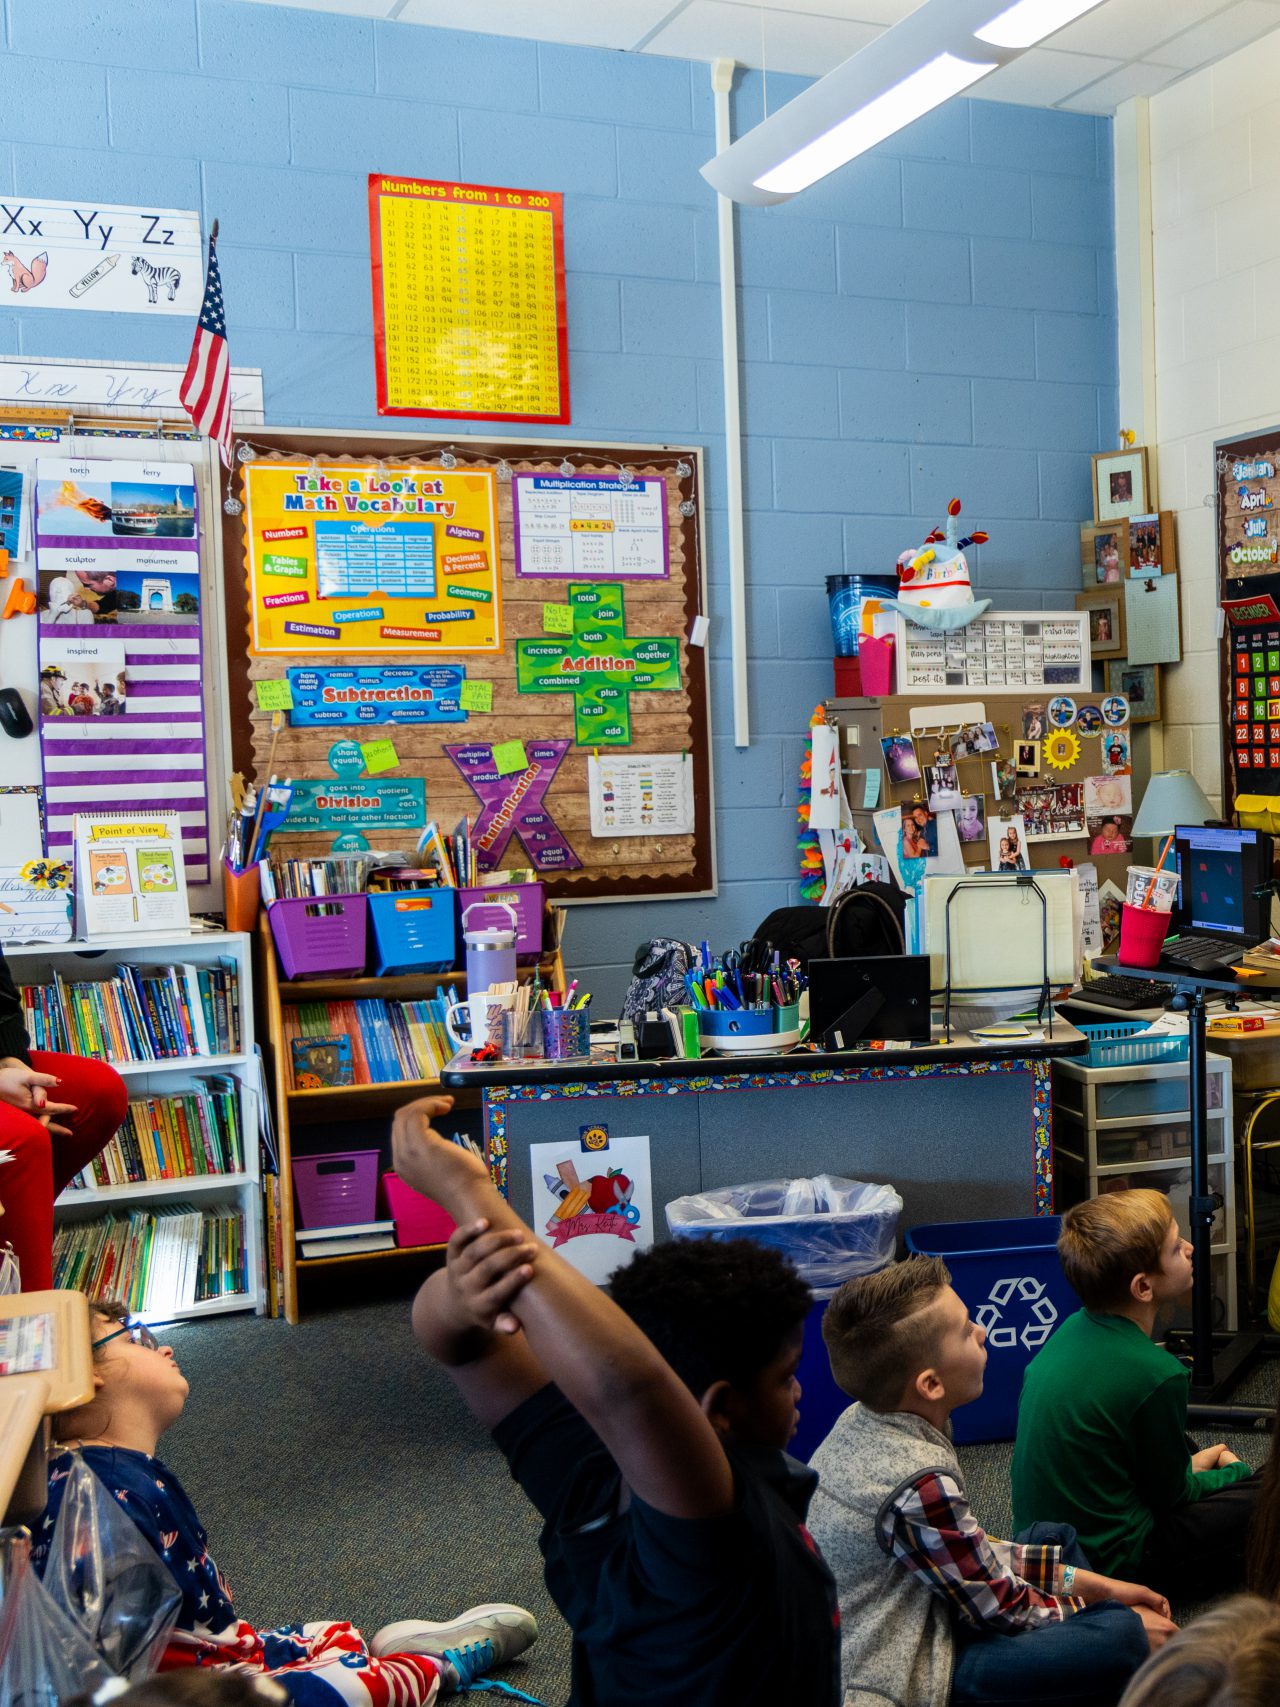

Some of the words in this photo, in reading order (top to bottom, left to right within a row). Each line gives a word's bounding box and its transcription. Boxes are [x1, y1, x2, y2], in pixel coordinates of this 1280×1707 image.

[381, 180, 446, 197] Numbers
[453, 187, 488, 201] from
[494, 193, 499, 202] 1
[507, 193, 522, 204] to
[528, 195, 550, 207] 200
[1, 205, 43, 236] Xx
[73, 210, 113, 250] Yy
[140, 215, 175, 245] Zz
[80, 269, 100, 287] YELLOW
[69, 466, 90, 475] torch
[143, 469, 161, 478] ferry
[1236, 463, 1274, 480] January
[296, 476, 342, 492] Take
[350, 480, 360, 492] a
[369, 478, 416, 493] Look
[424, 480, 443, 494] at
[540, 480, 597, 489] Multiplication
[599, 482, 640, 490] Strategies
[1241, 488, 1266, 510] April
[285, 495, 338, 510] Math
[345, 496, 455, 517] Vocabulary
[351, 525, 395, 534] Operations
[449, 527, 480, 538] Algebra
[1246, 520, 1267, 536] July
[265, 529, 304, 539] Numbers
[65, 556, 96, 565] sculptor
[1231, 547, 1273, 564] October
[136, 557, 178, 565] monument
[271, 556, 298, 566] Tables
[264, 564, 272, 572] &
[274, 565, 304, 575] Graphs
[577, 593, 596, 602] total
[428, 611, 471, 620] Probability
[383, 628, 438, 638] Measurement
[583, 633, 603, 641] both
[67, 647, 98, 656] inspired
[561, 657, 636, 672] Addition
[1271, 656, 1276, 666] 3
[539, 677, 580, 685] combined
[323, 687, 433, 703] Subtraction
[600, 689, 618, 697] plus
[392, 709, 425, 717] difference
[605, 727, 621, 735] add
[1237, 729, 1247, 739] 22
[377, 787, 409, 795] quotient
[316, 796, 381, 809] Division
[479, 763, 541, 850] Multiplication
[99, 827, 122, 836] Point
[127, 826, 136, 835] of
[140, 826, 159, 834] View
[149, 1001, 162, 1040] MUTATION
